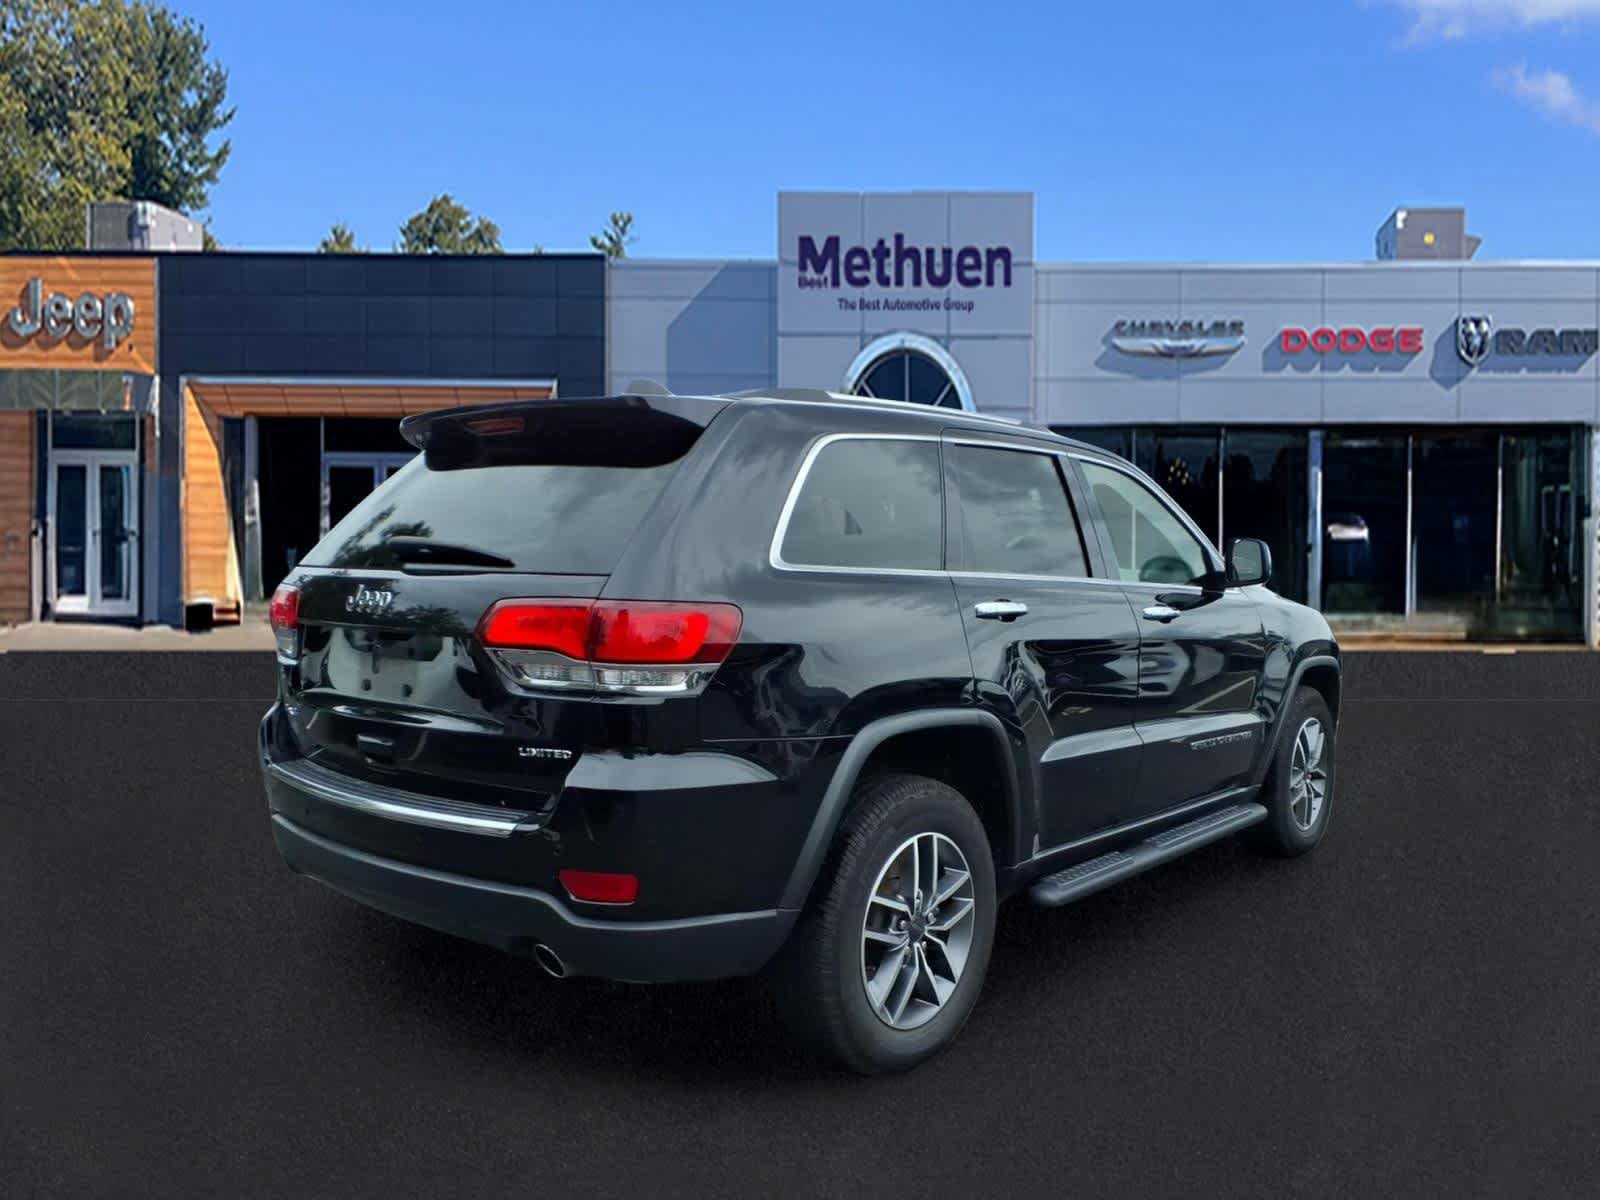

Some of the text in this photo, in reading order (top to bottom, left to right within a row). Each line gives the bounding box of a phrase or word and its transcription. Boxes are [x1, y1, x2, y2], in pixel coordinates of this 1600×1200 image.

[798, 233, 1012, 288] Methuen
[10, 277, 135, 349] Jeep
[837, 297, 975, 313] The Best Automotive Group
[1281, 327, 1424, 353] DODGE
[1495, 328, 1599, 355] RAM
[345, 583, 393, 615] Jeep
[518, 746, 573, 759] LIMITED
